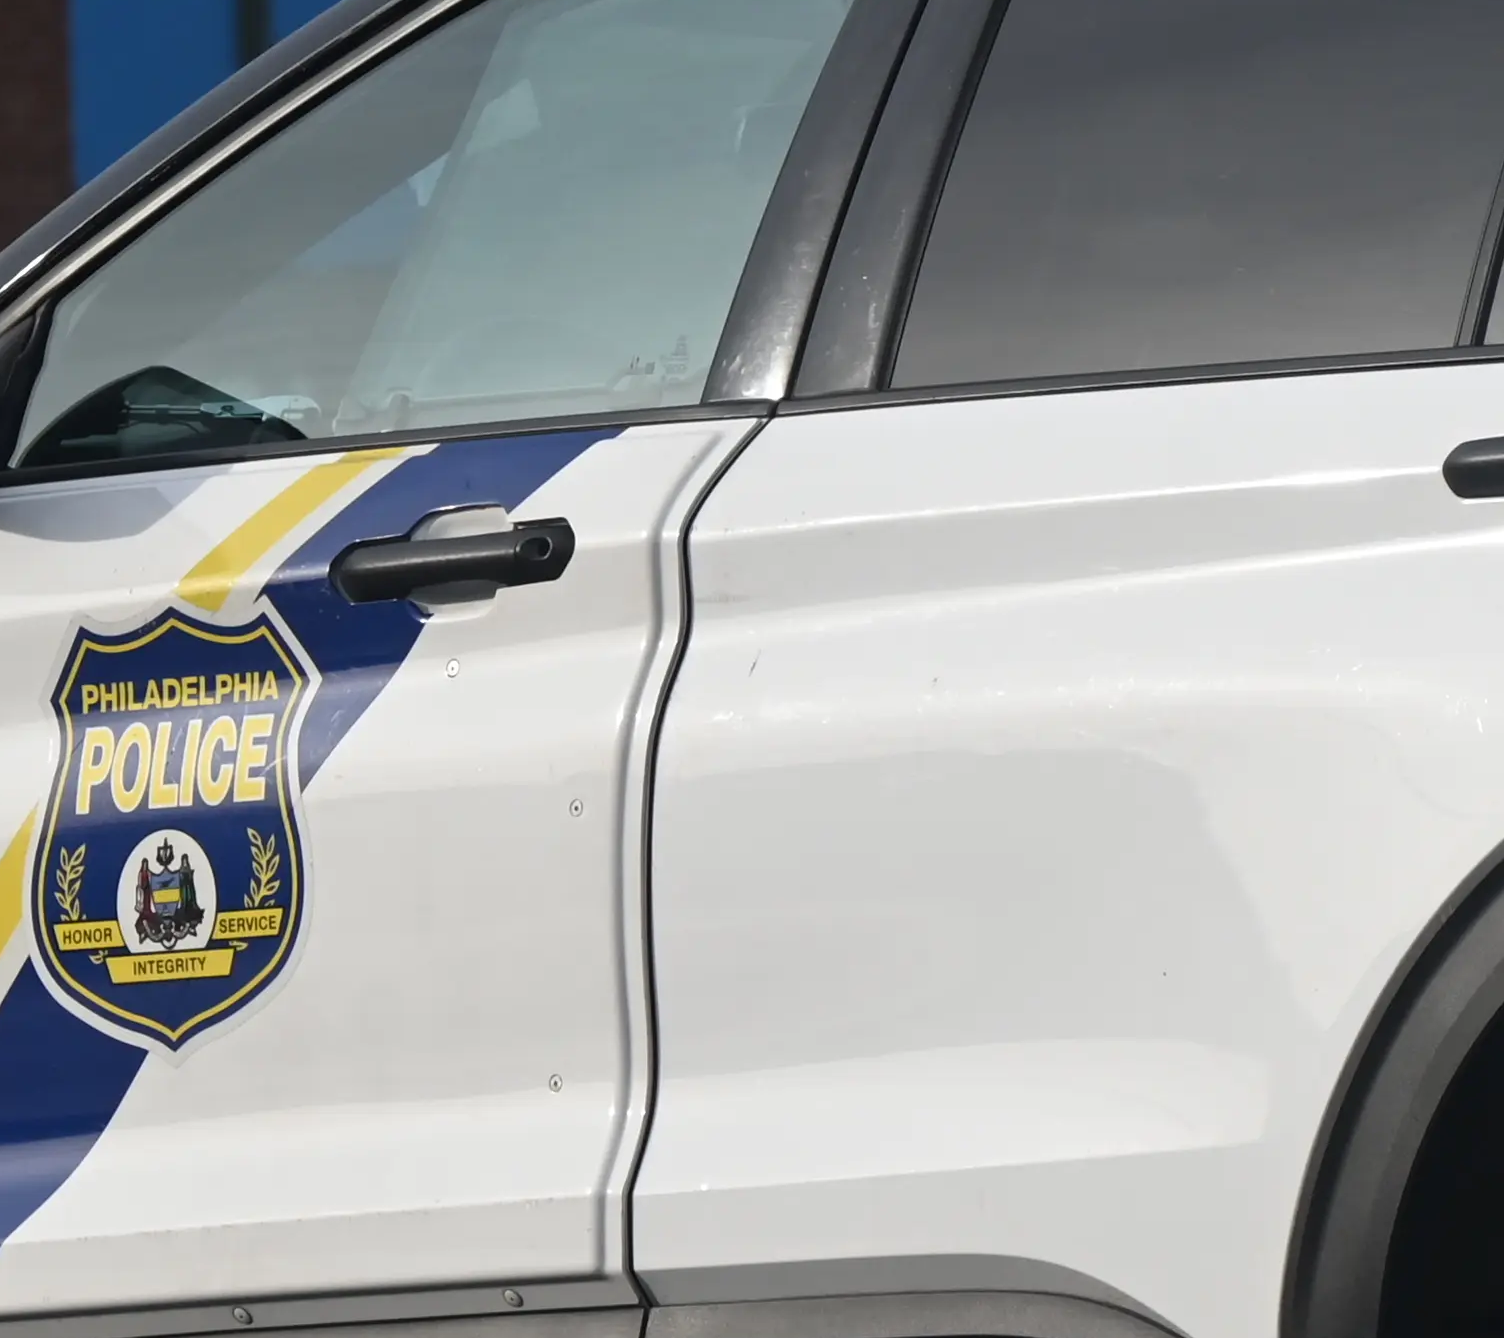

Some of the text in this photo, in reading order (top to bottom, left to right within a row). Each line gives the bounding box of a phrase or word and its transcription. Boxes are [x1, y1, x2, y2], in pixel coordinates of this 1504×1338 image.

[81, 670, 279, 714] PHILADELPHIA
[74, 714, 277, 816] POLICE
[62, 914, 277, 945] HONOR SERVICE
[133, 956, 206, 976] INTEGRITY
